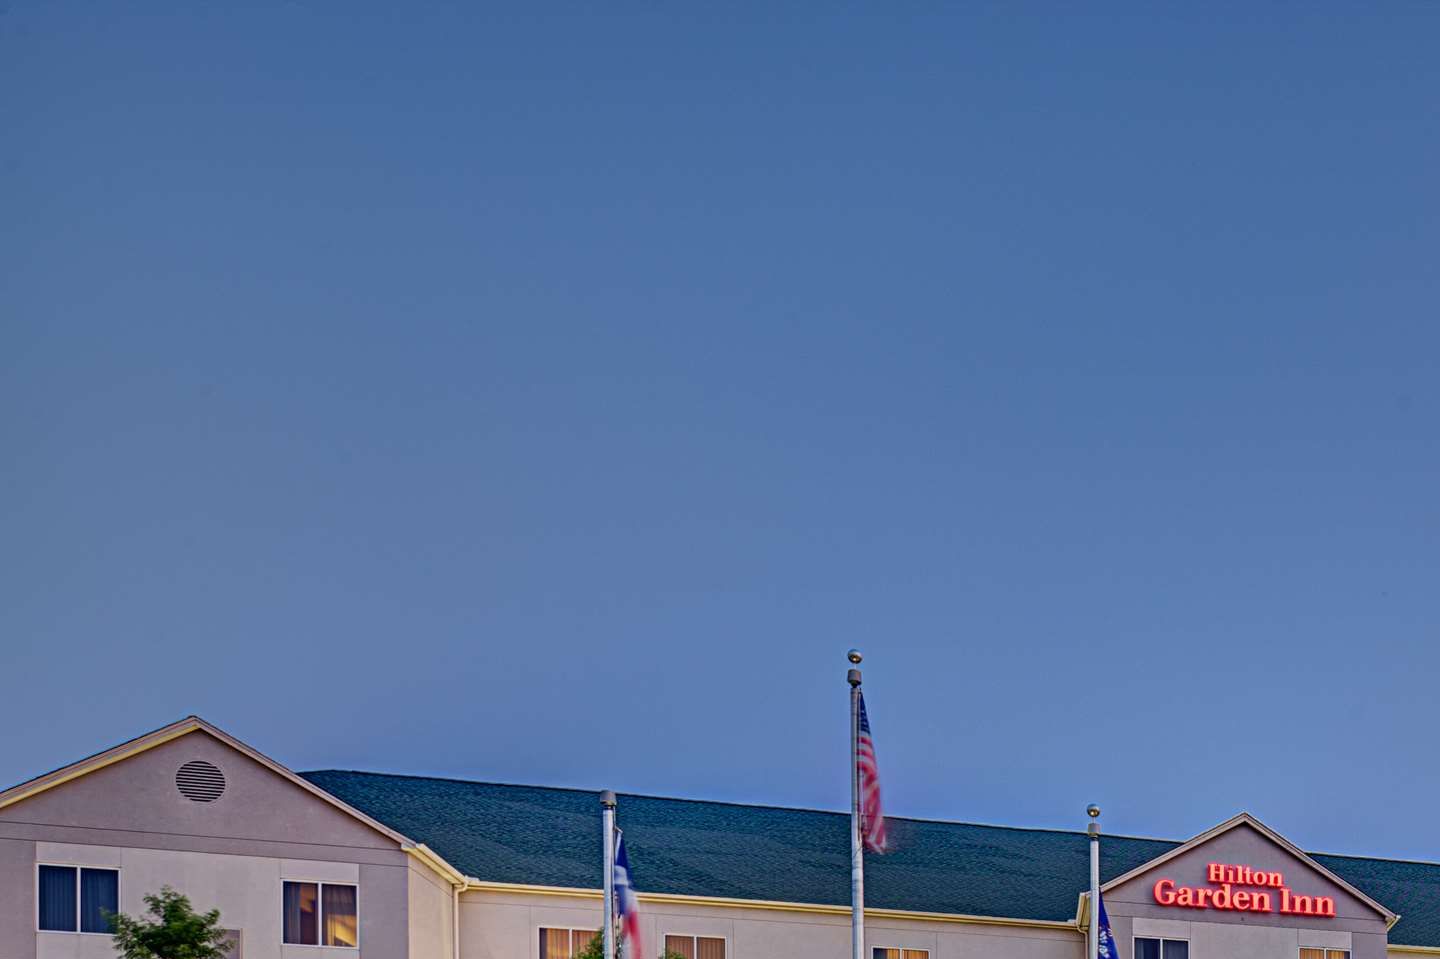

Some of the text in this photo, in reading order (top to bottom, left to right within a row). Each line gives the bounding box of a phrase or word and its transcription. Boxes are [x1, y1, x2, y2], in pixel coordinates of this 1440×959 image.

[1208, 863, 1283, 887] Hilton
[1153, 879, 1336, 917] Garden Inn
